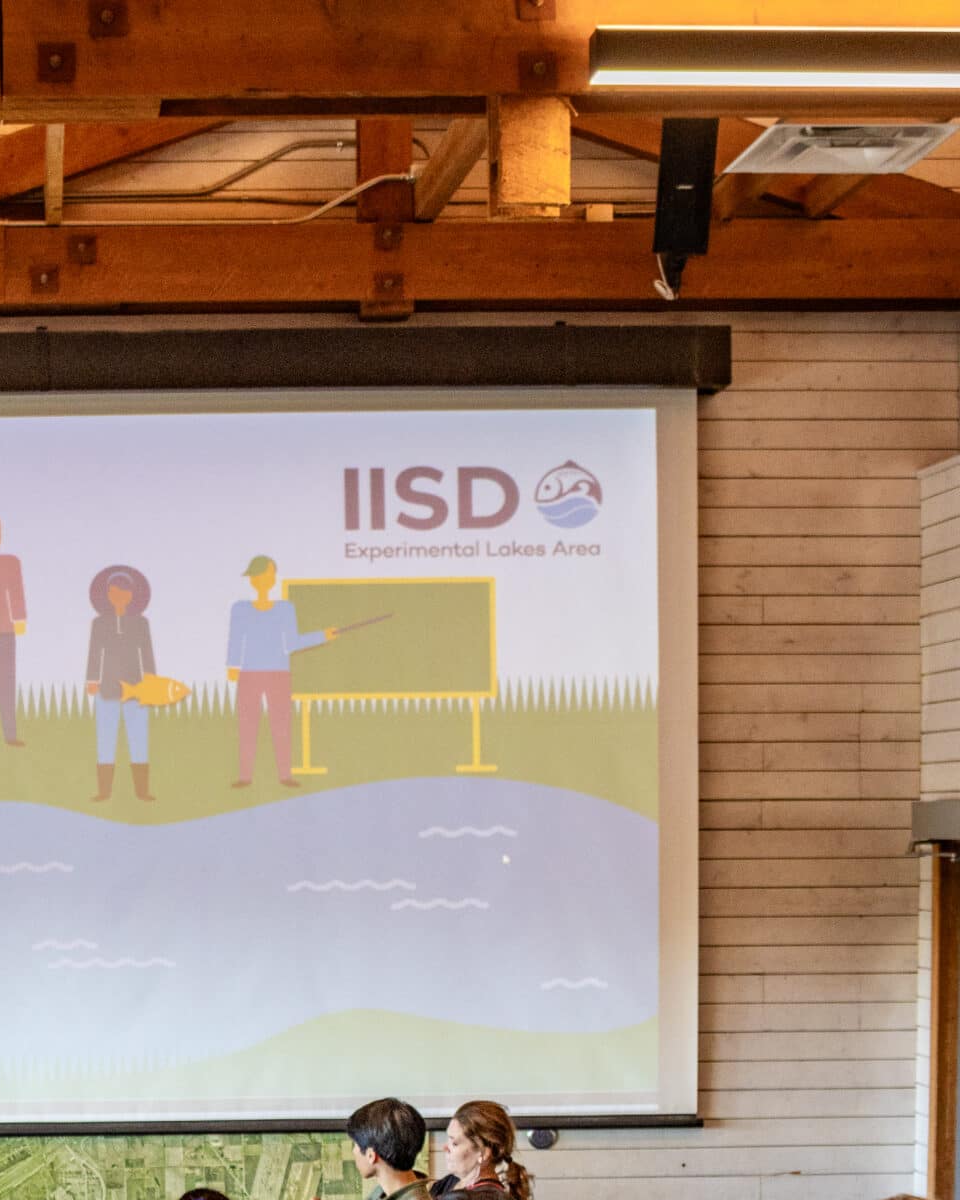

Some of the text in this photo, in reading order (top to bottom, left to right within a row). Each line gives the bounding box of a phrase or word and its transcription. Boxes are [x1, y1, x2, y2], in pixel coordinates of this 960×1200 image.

[344, 467, 520, 531] IISD
[345, 540, 601, 562] Experimental Lakes Area
